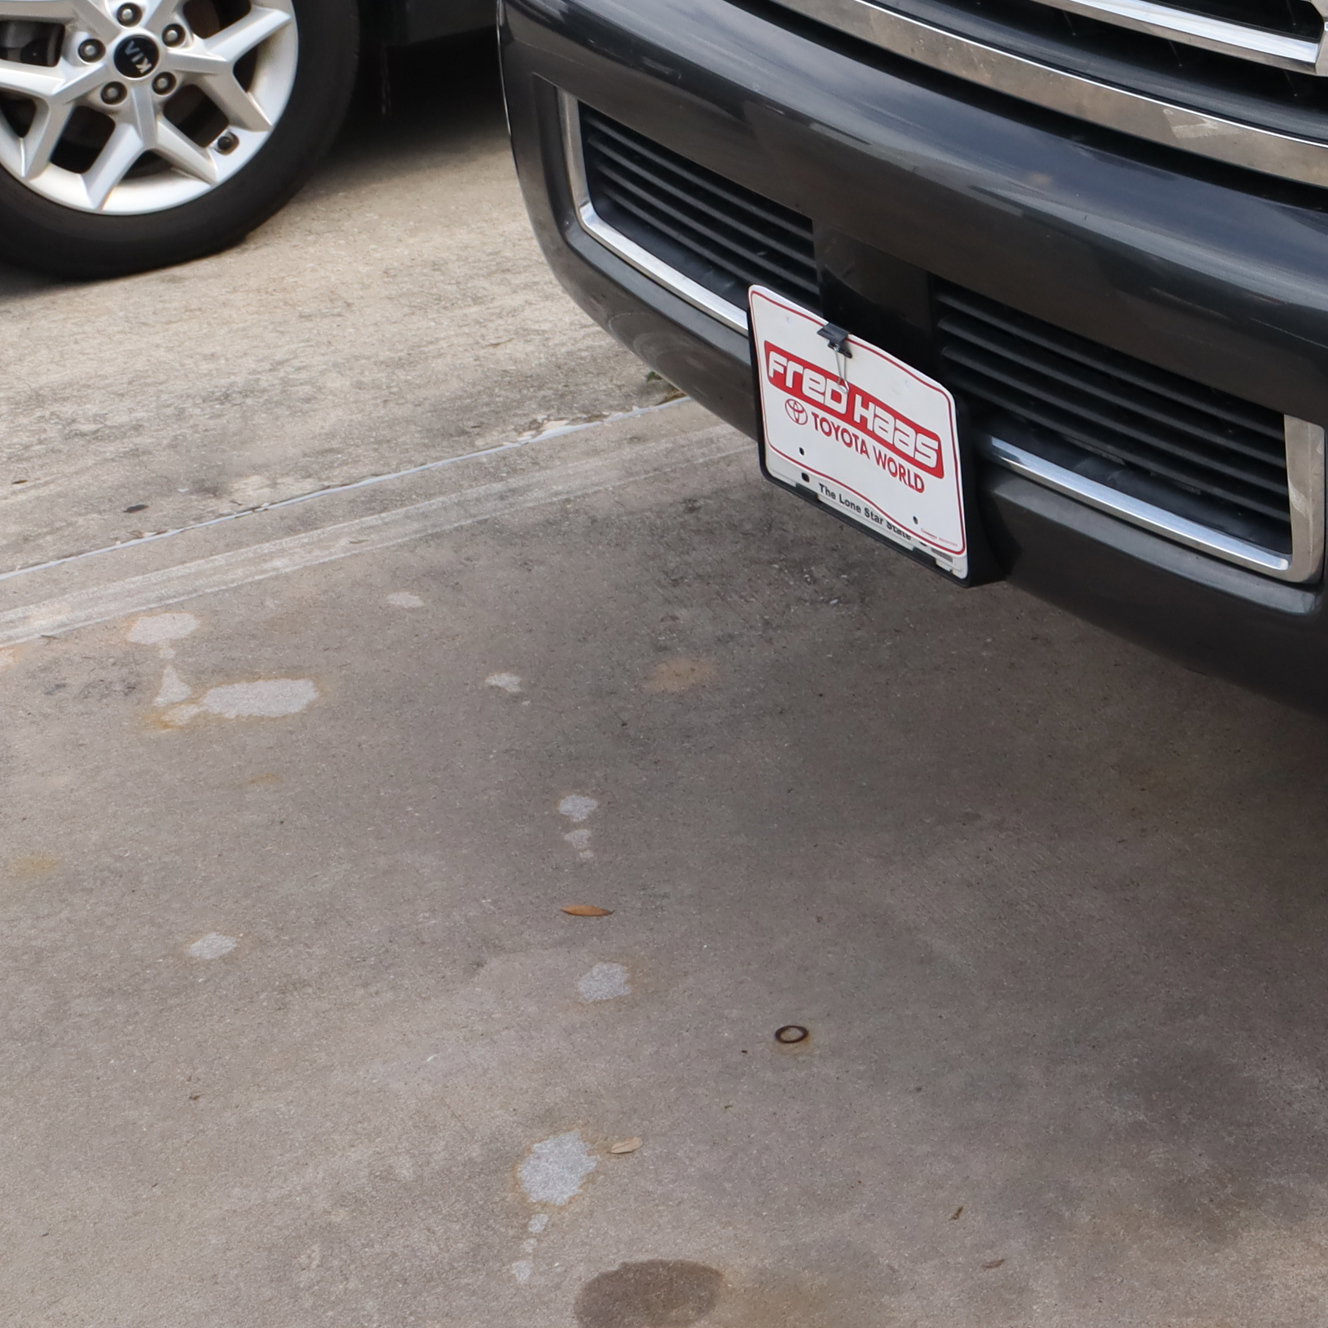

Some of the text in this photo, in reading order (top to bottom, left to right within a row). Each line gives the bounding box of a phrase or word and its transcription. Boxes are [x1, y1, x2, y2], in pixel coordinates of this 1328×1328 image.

[125, 40, 152, 74] KIA
[811, 412, 925, 494] TOYOTA WORLD
[818, 483, 836, 500] The
[839, 494, 862, 514] Lone
[864, 507, 884, 525] Star
